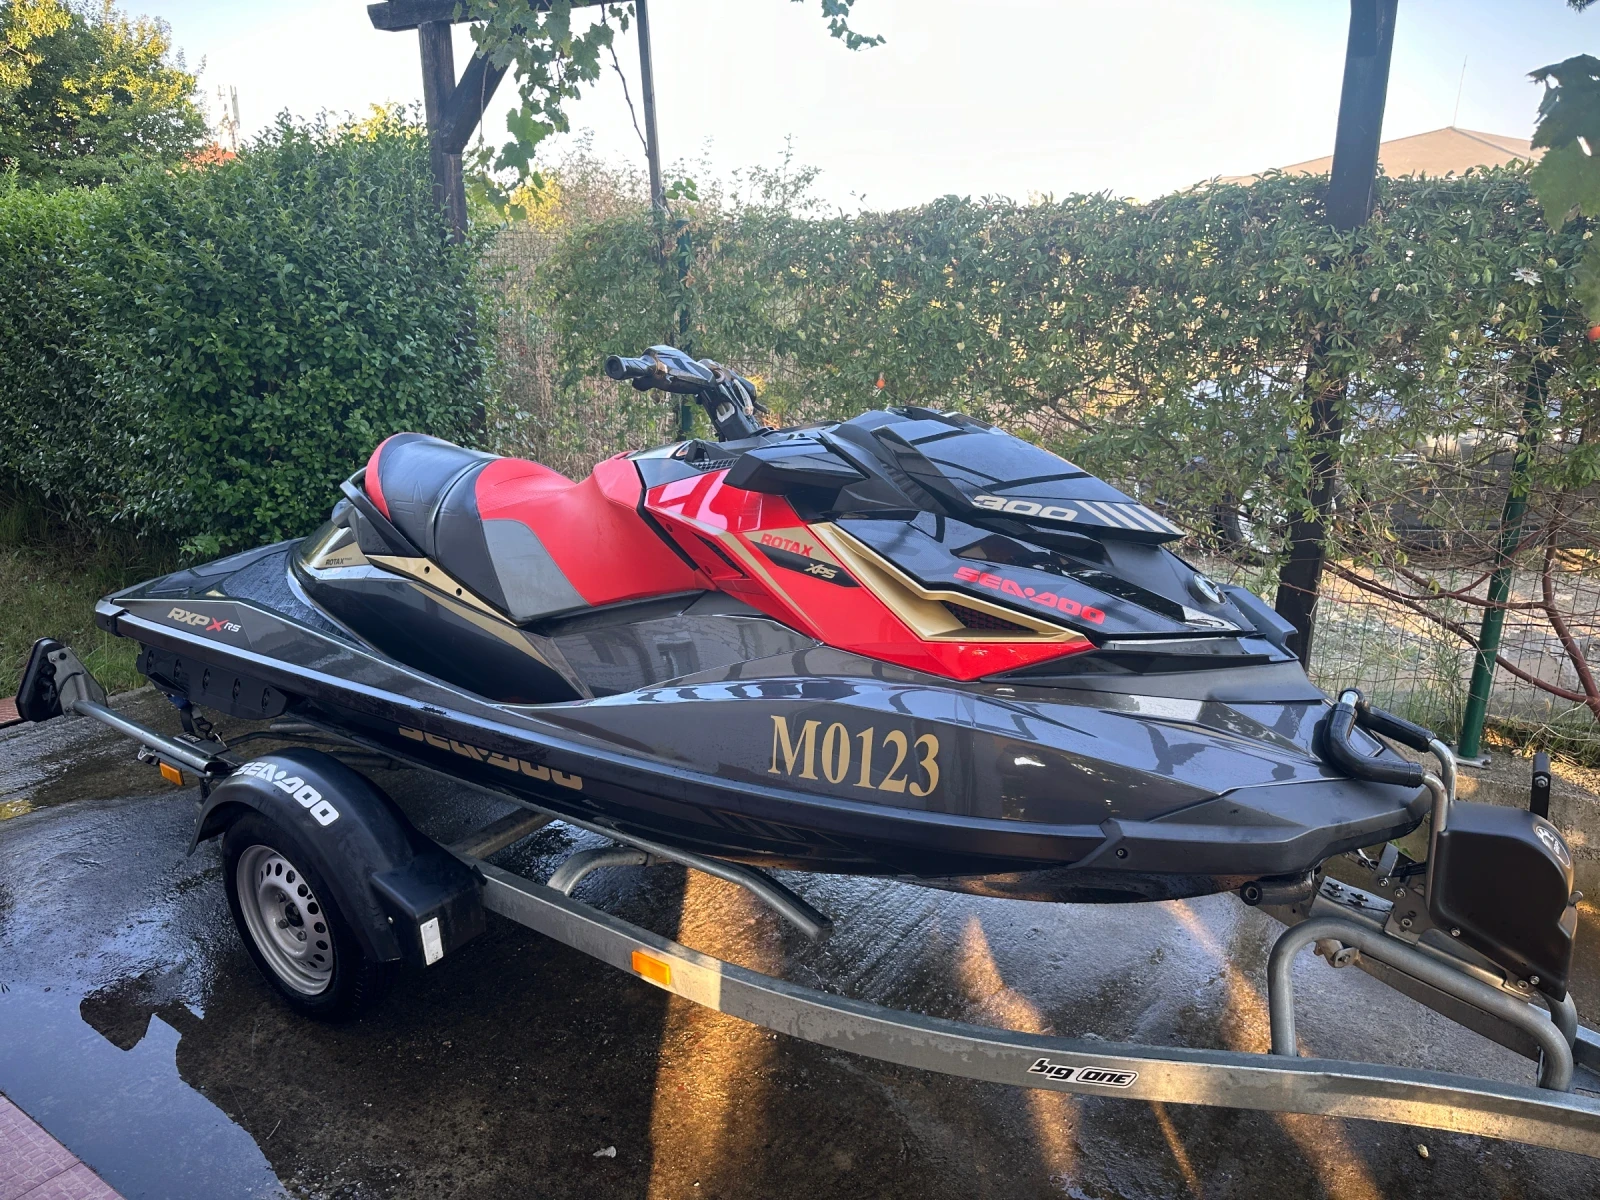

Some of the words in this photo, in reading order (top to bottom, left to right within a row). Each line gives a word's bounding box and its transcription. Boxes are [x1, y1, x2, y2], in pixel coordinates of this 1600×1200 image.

[971, 495, 1079, 522] 300
[760, 533, 814, 558] ROTAX
[325, 557, 344, 566] ROTAX
[804, 563, 839, 579] XPS
[767, 715, 940, 797] M0123
